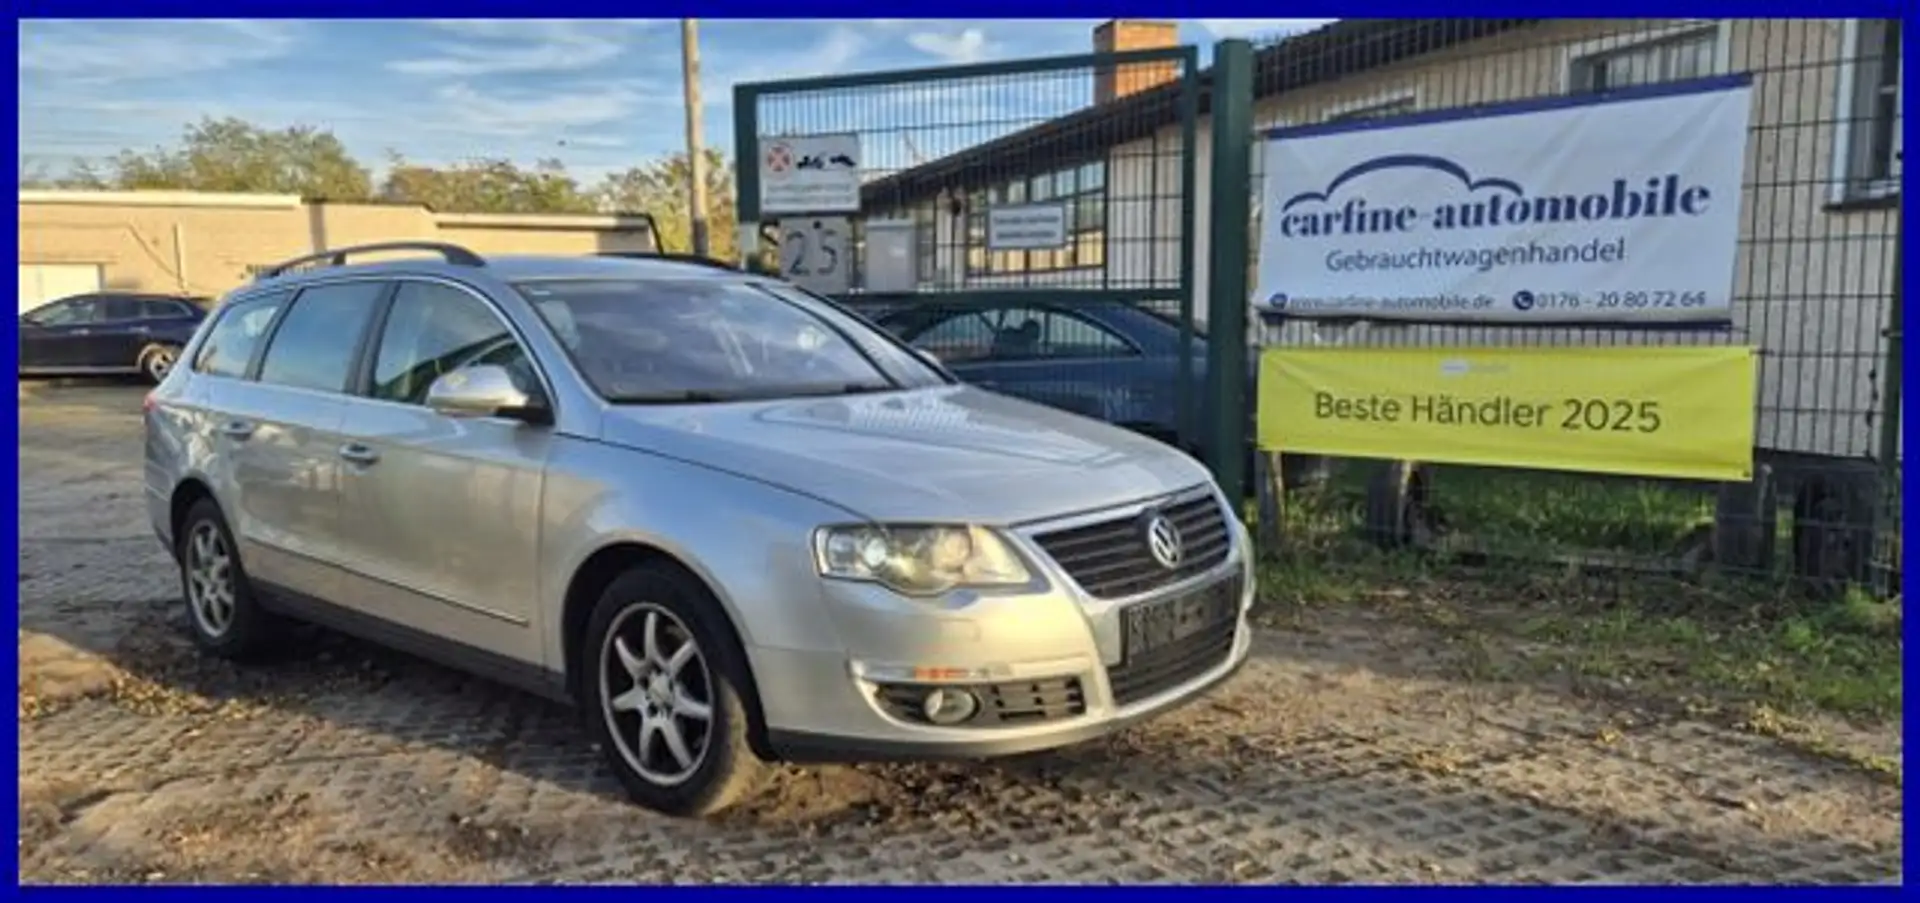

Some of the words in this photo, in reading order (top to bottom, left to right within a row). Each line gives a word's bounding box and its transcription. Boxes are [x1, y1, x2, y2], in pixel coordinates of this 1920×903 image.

[785, 229, 839, 276] 25
[1325, 238, 1626, 273] Gebrauchtwagenhandel
[1535, 292, 1580, 308] 0176
[1596, 291, 1620, 308] 20
[1623, 291, 1648, 307] 80
[1653, 291, 1677, 307] 72
[1315, 391, 1401, 422] Beste
[1411, 393, 1552, 428] Händler
[1561, 398, 1662, 433] 2025
